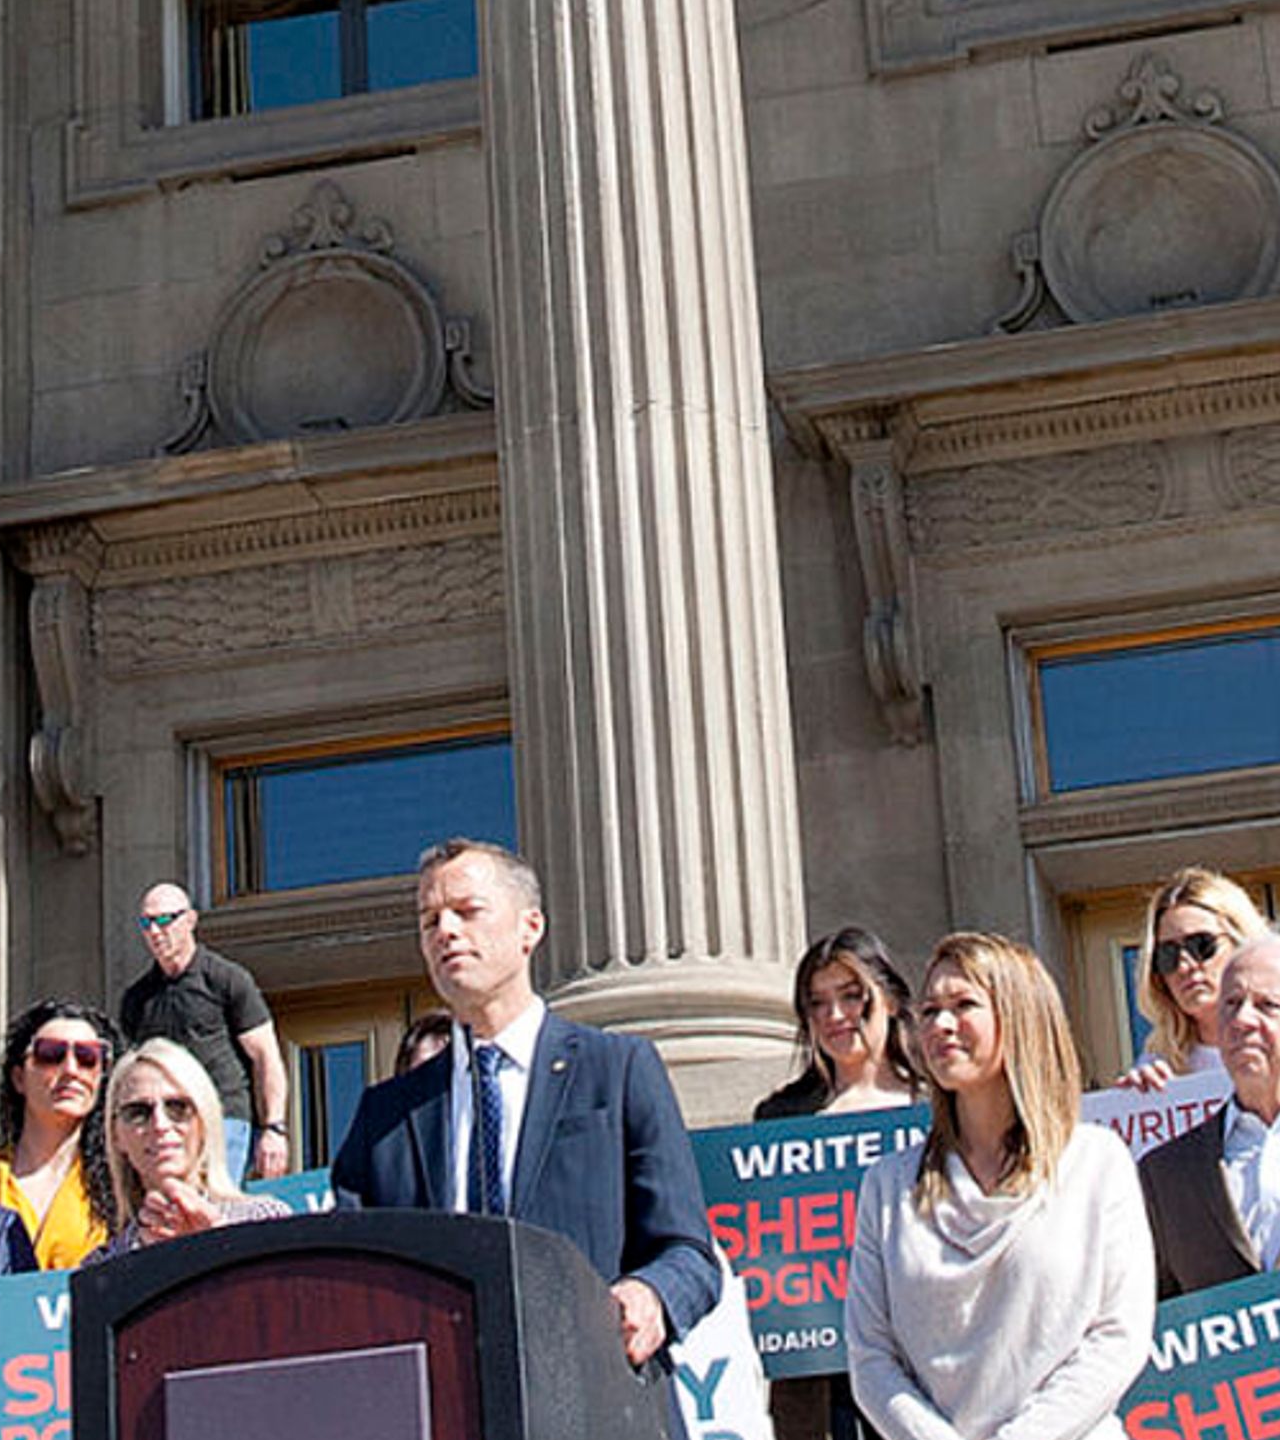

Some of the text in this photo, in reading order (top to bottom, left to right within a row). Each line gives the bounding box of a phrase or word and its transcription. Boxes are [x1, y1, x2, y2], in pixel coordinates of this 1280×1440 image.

[731, 1132, 882, 1180] WRITE
[706, 1190, 856, 1260] SHE
[758, 1328, 837, 1353] IDAHO
